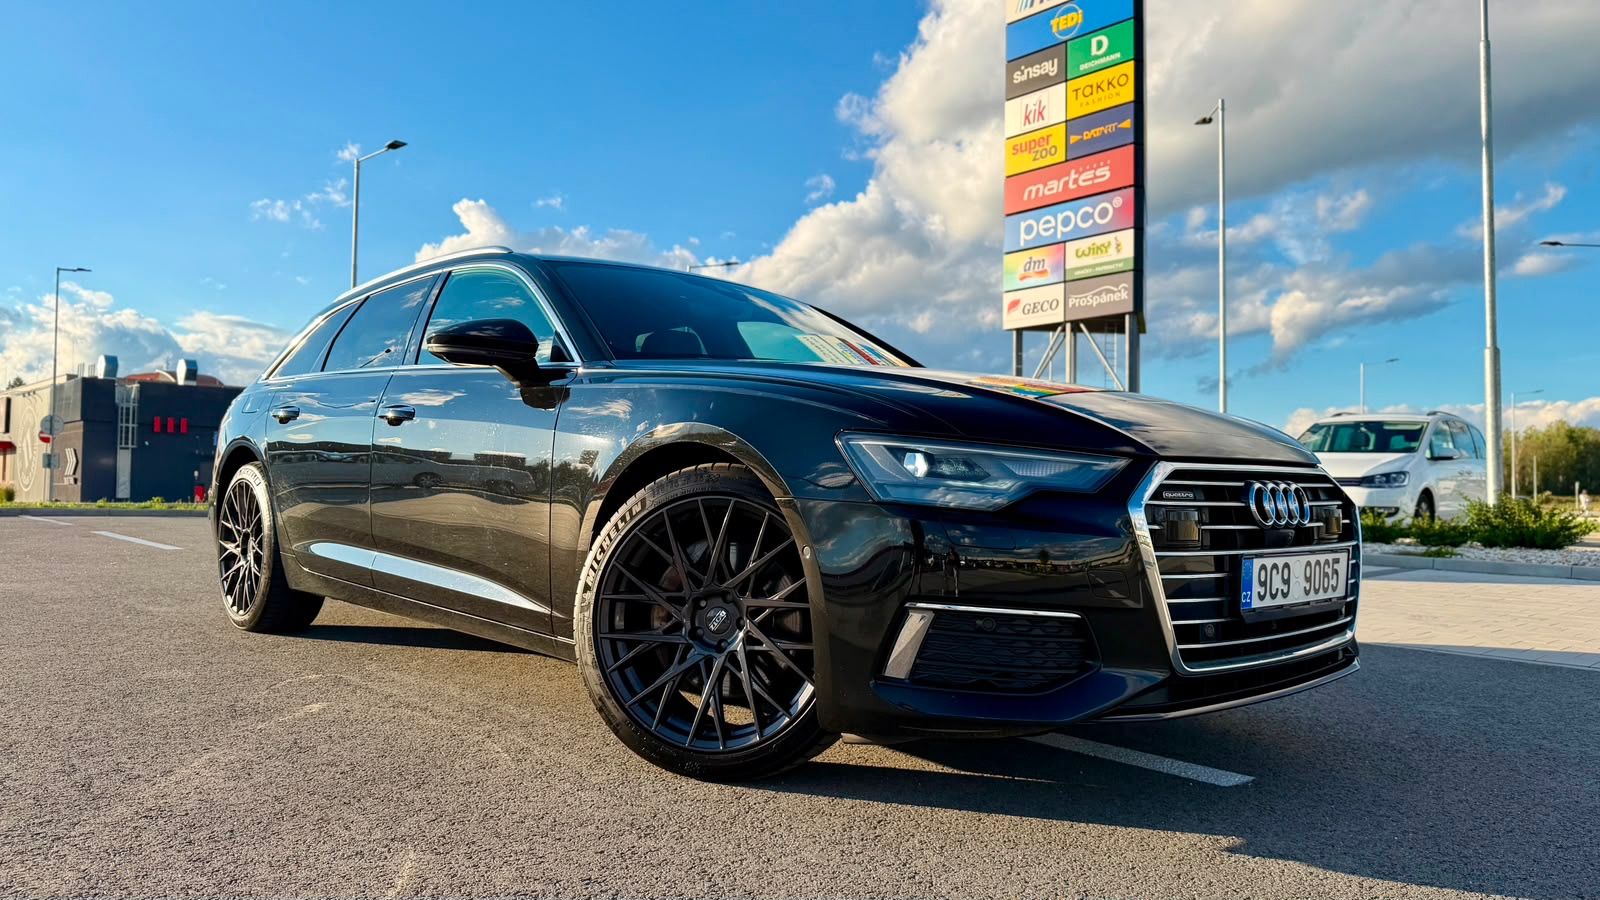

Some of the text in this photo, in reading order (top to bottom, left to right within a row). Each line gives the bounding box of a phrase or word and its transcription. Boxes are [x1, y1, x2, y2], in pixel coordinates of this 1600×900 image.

[1091, 35, 1109, 56] D
[1013, 58, 1058, 84] sinsay
[1079, 52, 1121, 71] DEICHMANN
[1023, 99, 1046, 127] kik
[1012, 134, 1053, 156] super
[1023, 165, 1111, 201] martes
[1023, 256, 1046, 273] dm
[1022, 298, 1059, 315] GECO
[585, 500, 643, 588] MICHELIN
[1257, 557, 1341, 602] 9C9 9065
[1241, 591, 1251, 603] CZ
